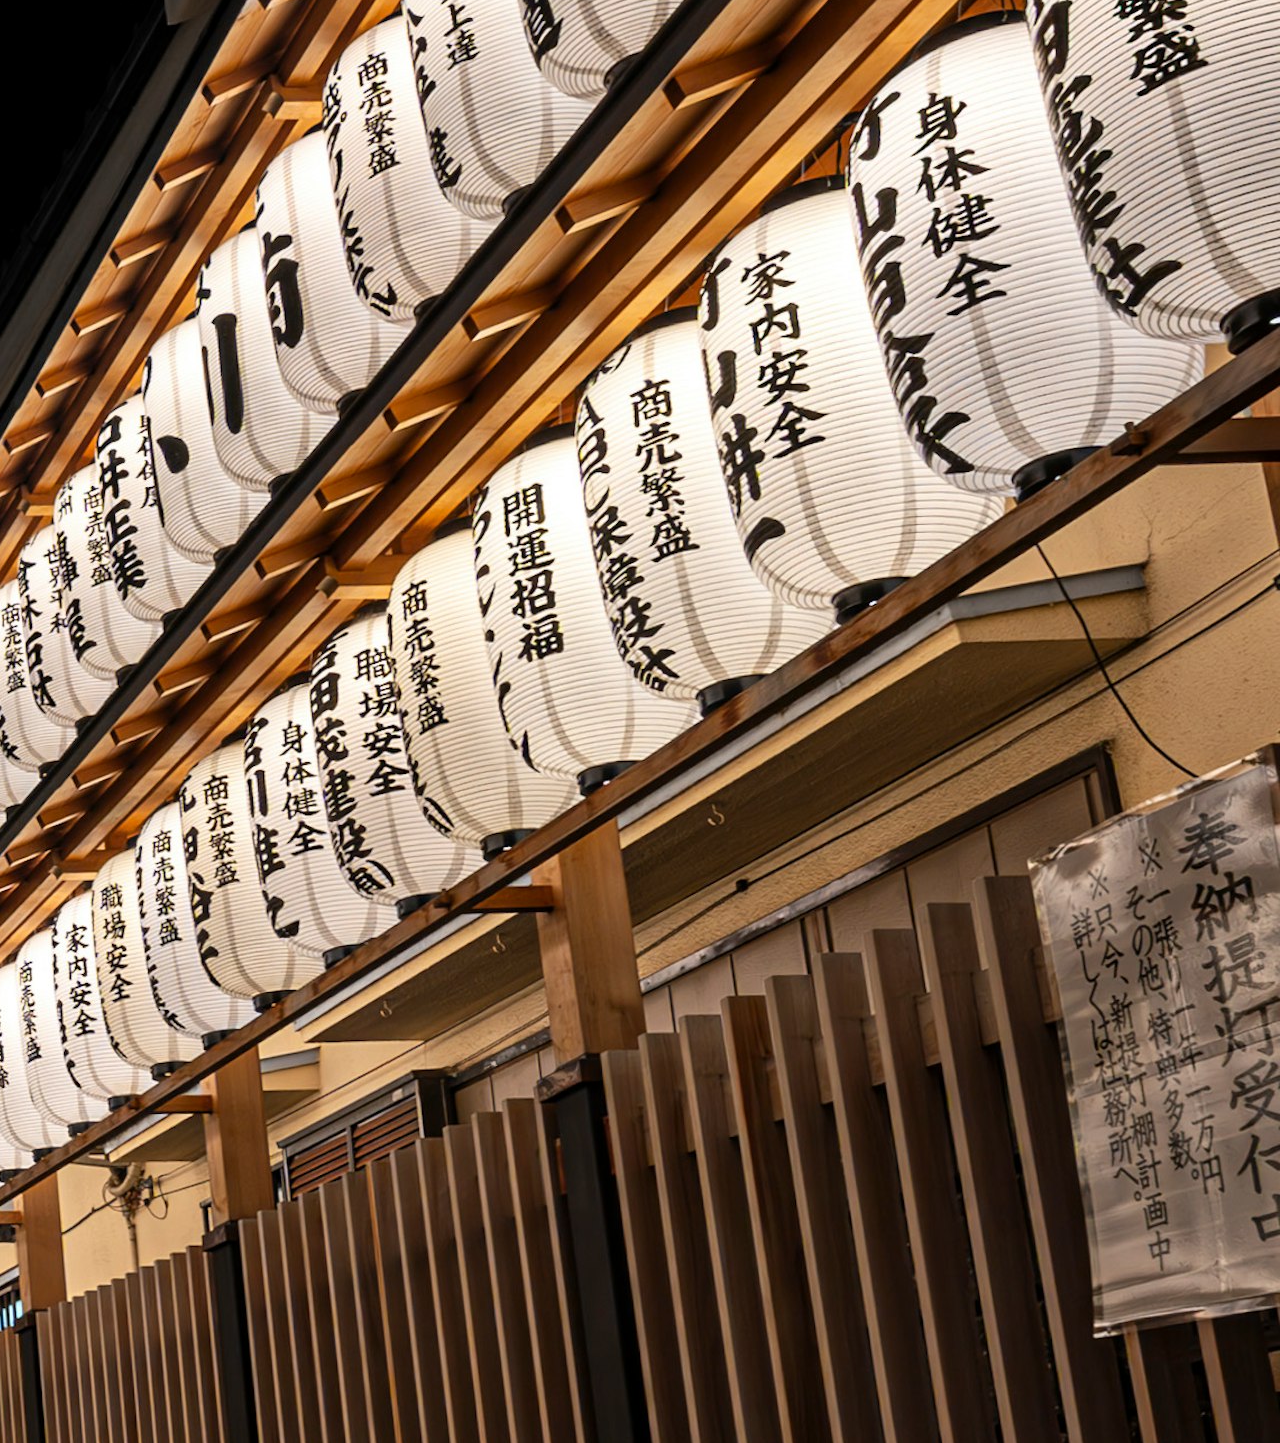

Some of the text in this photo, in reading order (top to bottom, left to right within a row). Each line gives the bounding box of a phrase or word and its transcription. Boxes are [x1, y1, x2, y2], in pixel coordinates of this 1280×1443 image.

[357, 50, 402, 180] 商売繁盛
[911, 92, 1012, 318] 身体健全
[740, 249, 828, 461] 家内安全
[629, 377, 700, 564] 商売繁盛
[501, 482, 565, 662] 開運招福
[0, 602, 27, 694] 商売繁盛
[399, 581, 450, 735] 商売繁盛
[279, 719, 327, 856] 身体健全
[354, 646, 410, 797] 職場安全
[150, 828, 183, 946] 商売繁盛
[202, 775, 241, 889] 商売繁盛
[64, 923, 97, 1038] 家内安全
[99, 883, 134, 1004] 職場安全
[17, 960, 42, 1062] 商売繁盛
